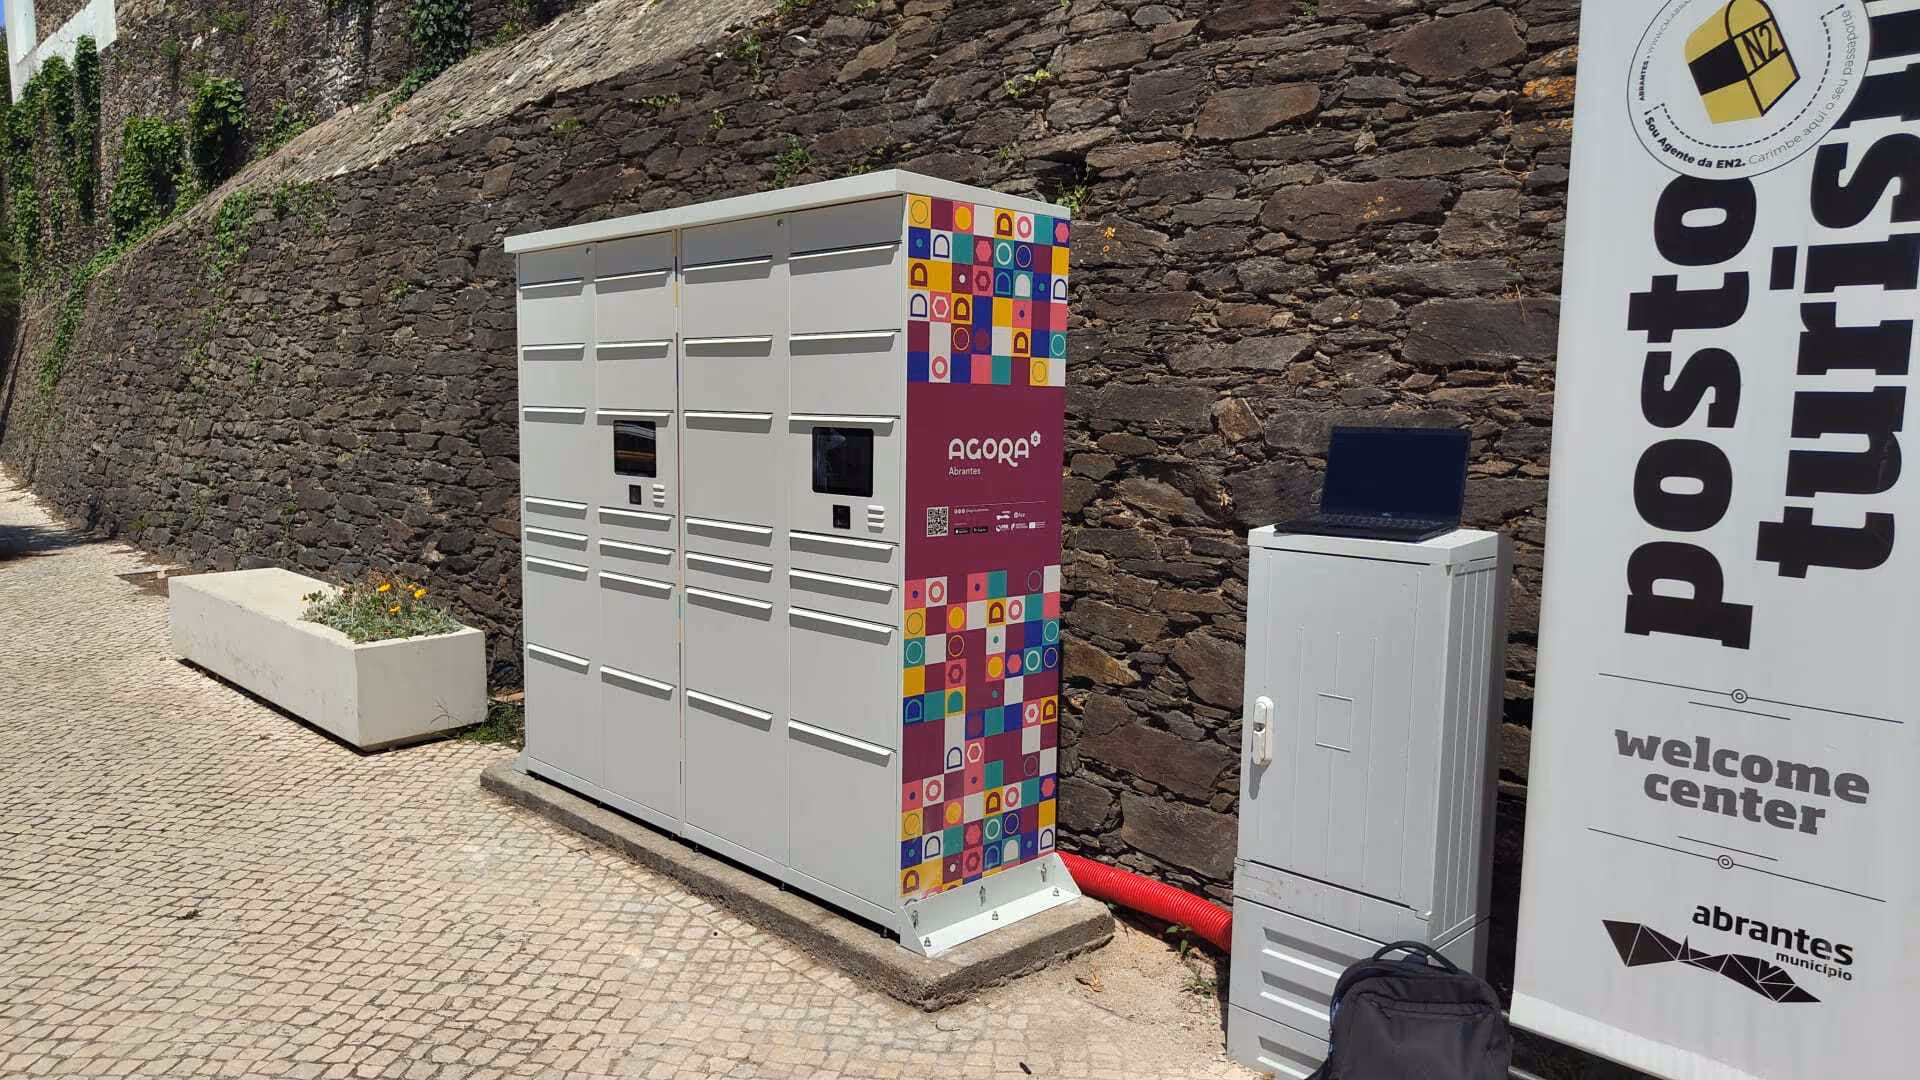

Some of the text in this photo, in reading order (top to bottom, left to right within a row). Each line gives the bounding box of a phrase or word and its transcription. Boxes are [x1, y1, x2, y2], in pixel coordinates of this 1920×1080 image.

[1742, 24, 1779, 70] N2
[1638, 60, 1649, 101] ABRANTES
[1644, 9, 1859, 169] Sou Agente da EN2. Carimbe aqui o seu passaporte
[1625, 174, 1757, 650] posto
[948, 437, 1029, 467] AGORA
[948, 466, 981, 476] Abrantes
[1615, 728, 1870, 805] welcome
[1643, 772, 1826, 836] center
[1692, 904, 1853, 966] abrantes
